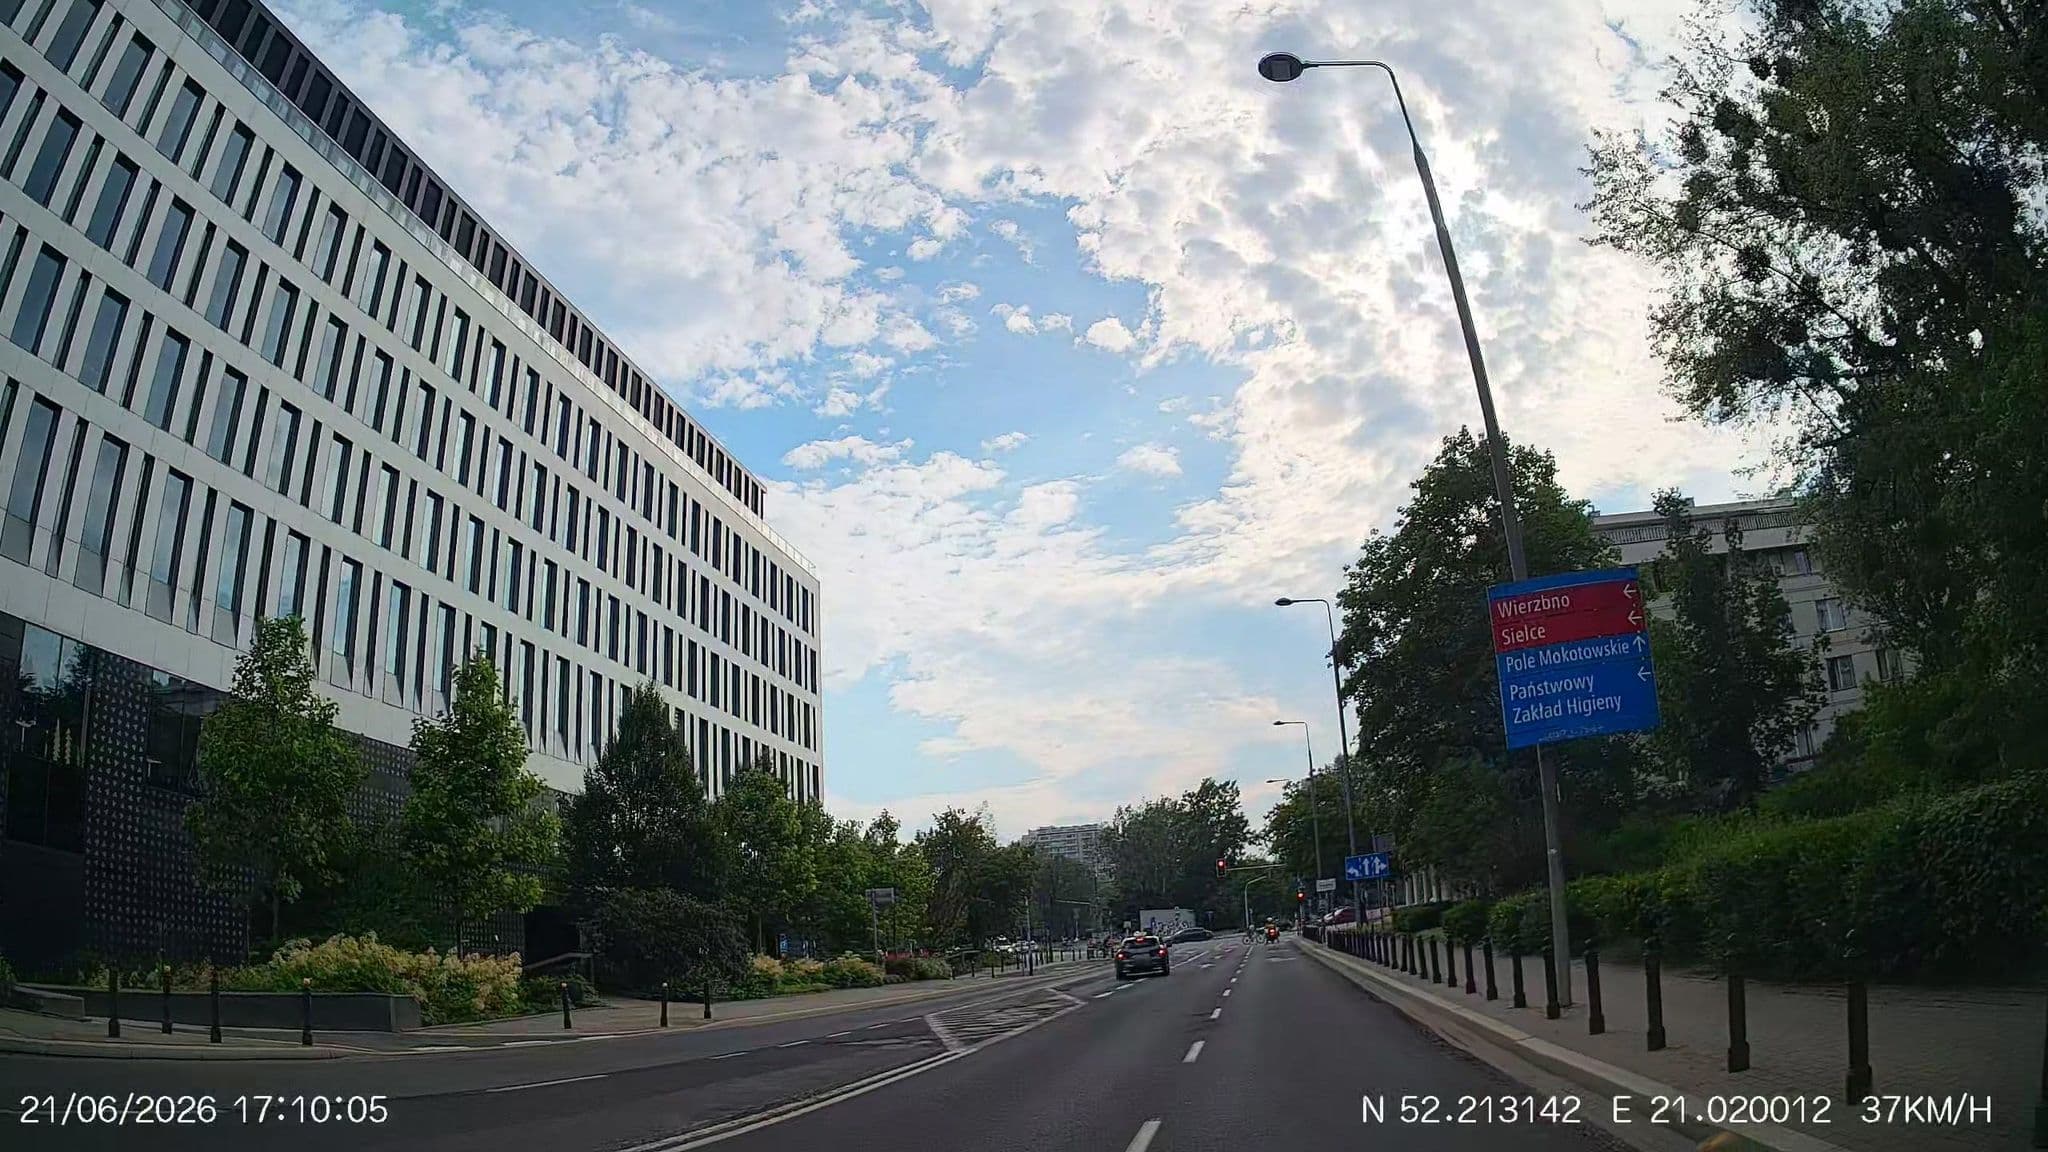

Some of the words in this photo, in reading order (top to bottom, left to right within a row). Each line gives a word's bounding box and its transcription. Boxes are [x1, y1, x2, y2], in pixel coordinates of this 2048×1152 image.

[1497, 595, 1570, 618] Wierzbno
[1502, 624, 1546, 645] Sielce
[1506, 652, 1536, 672] Pole
[1539, 640, 1630, 666] Mokotowskie
[1510, 675, 1594, 700] Państwowy
[1513, 699, 1562, 724] Zakład
[1567, 695, 1622, 717] Higieny
